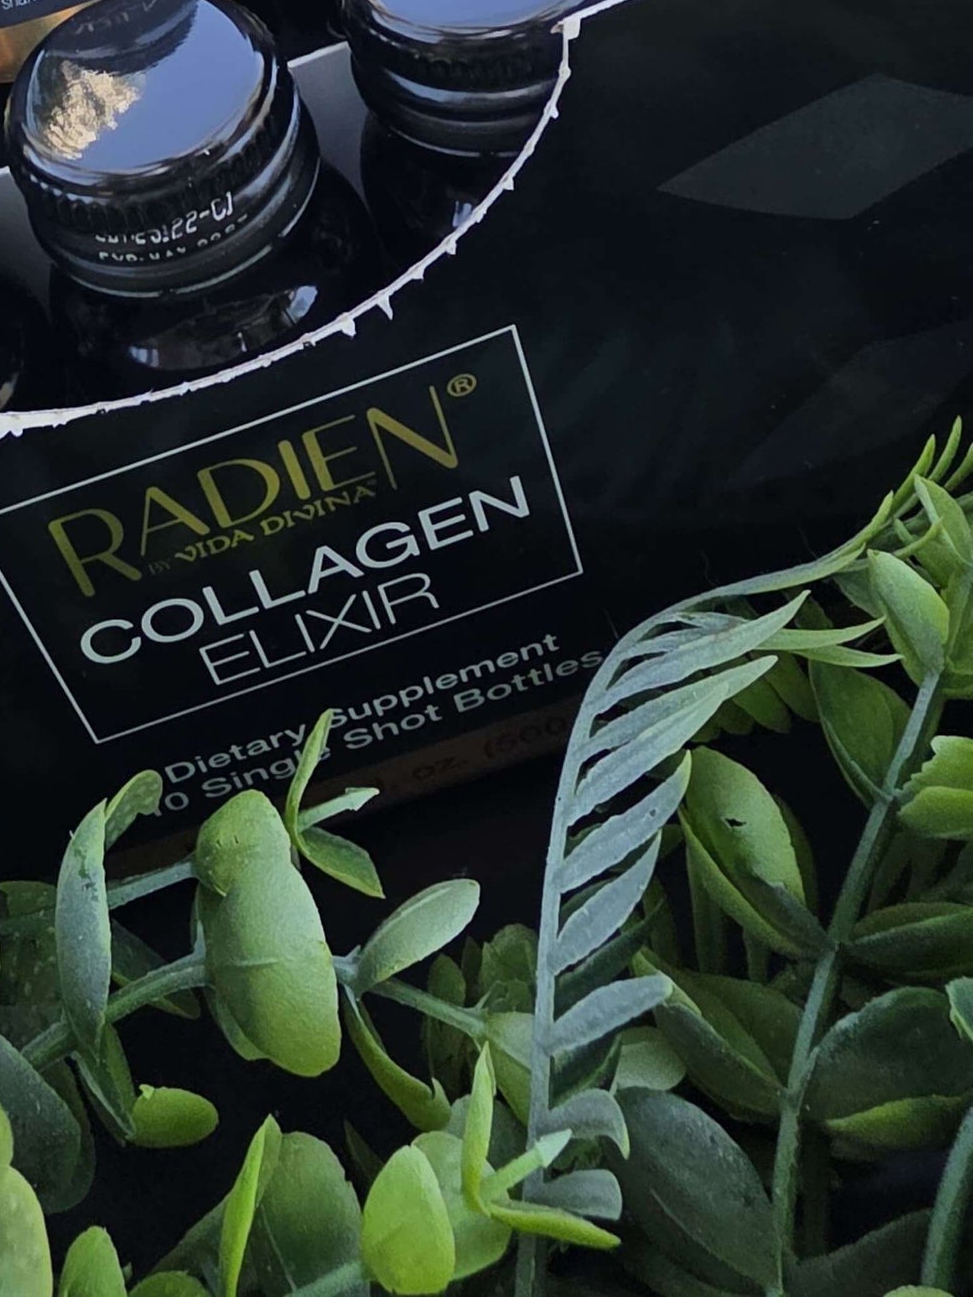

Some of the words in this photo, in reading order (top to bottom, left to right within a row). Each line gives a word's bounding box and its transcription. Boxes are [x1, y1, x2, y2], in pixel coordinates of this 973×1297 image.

[80, 475, 530, 665] COLLAGEN
[174, 529, 254, 562] VIDA
[260, 486, 375, 536] DIVINA
[199, 572, 440, 686] ELIXIR
[155, 792, 189, 817] 0
[343, 704, 444, 750] Shot
[453, 651, 605, 713] Bottles
[165, 724, 306, 783] Dietary
[328, 634, 559, 729] Supplement
